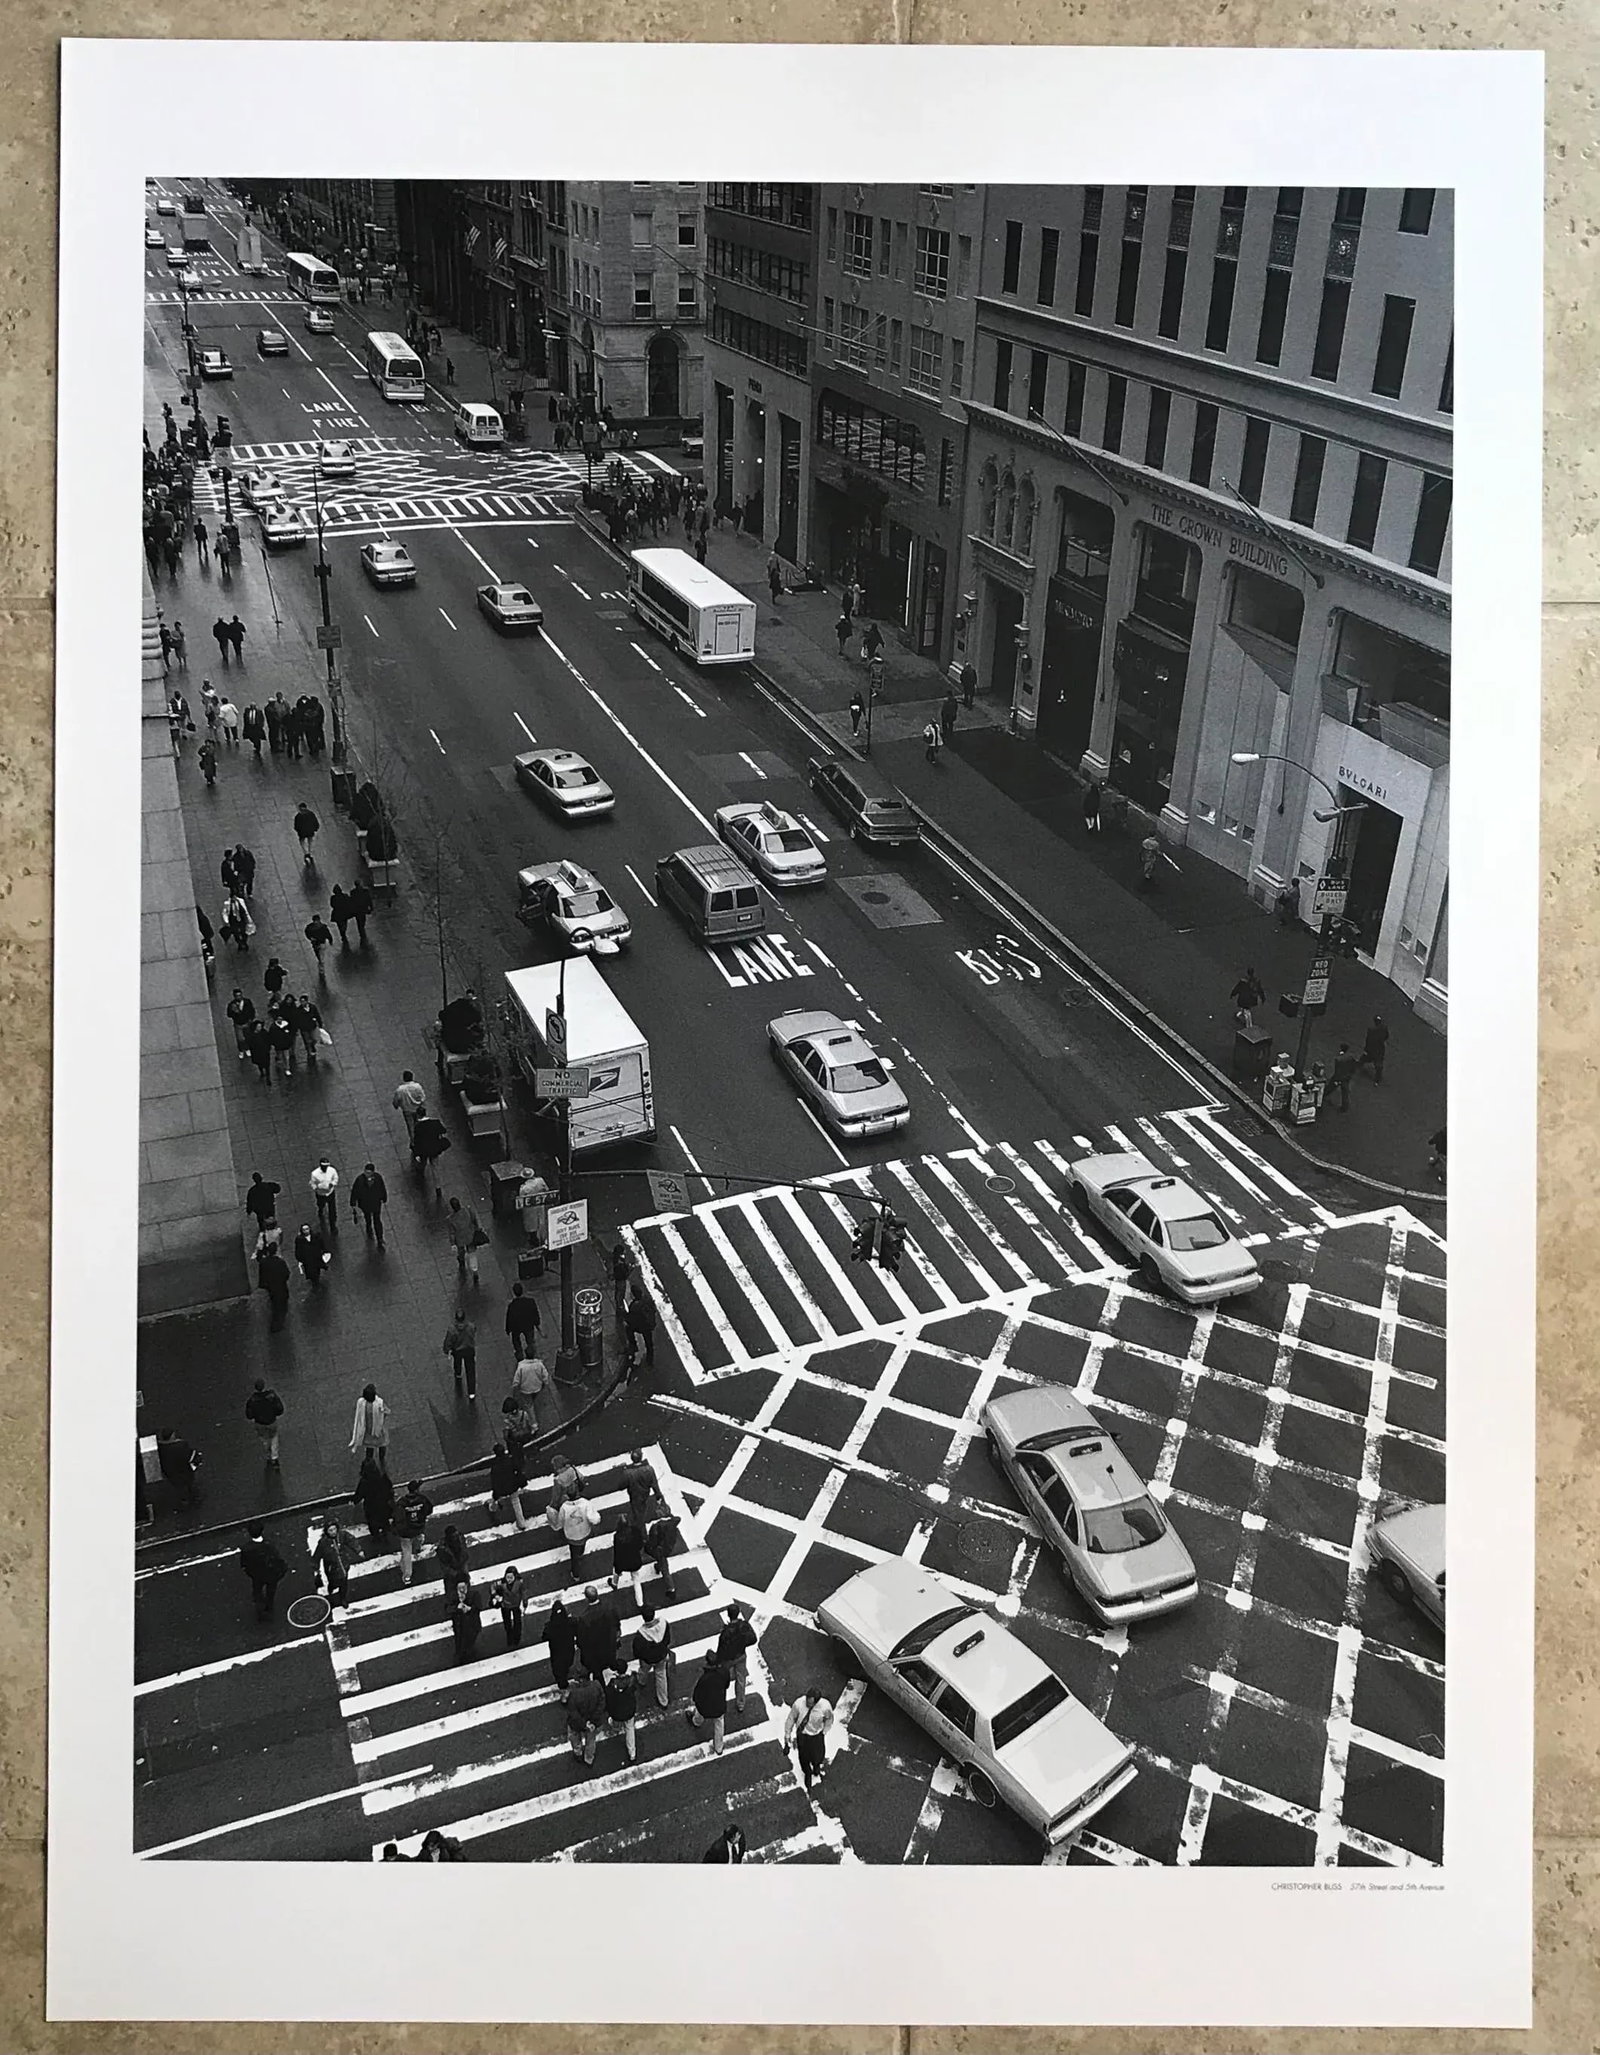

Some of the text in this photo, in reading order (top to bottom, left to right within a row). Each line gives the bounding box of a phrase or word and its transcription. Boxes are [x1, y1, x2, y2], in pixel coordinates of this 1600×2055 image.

[301, 401, 346, 413] LANE
[312, 418, 360, 428] FIRE
[1151, 503, 1288, 576] THE CROWN BUILDING
[1338, 765, 1387, 800] BVLGARI
[703, 934, 815, 988] LANE
[554, 1071, 571, 1079] NO
[535, 1194, 547, 1204] 57
[1271, 1882, 1322, 1891] CHRISTOPHER
[1350, 1882, 1366, 1891] 57th
[1368, 1882, 1389, 1891] Street
[1389, 1882, 1403, 1891] and
[1419, 1883, 1445, 1891] Avenue
